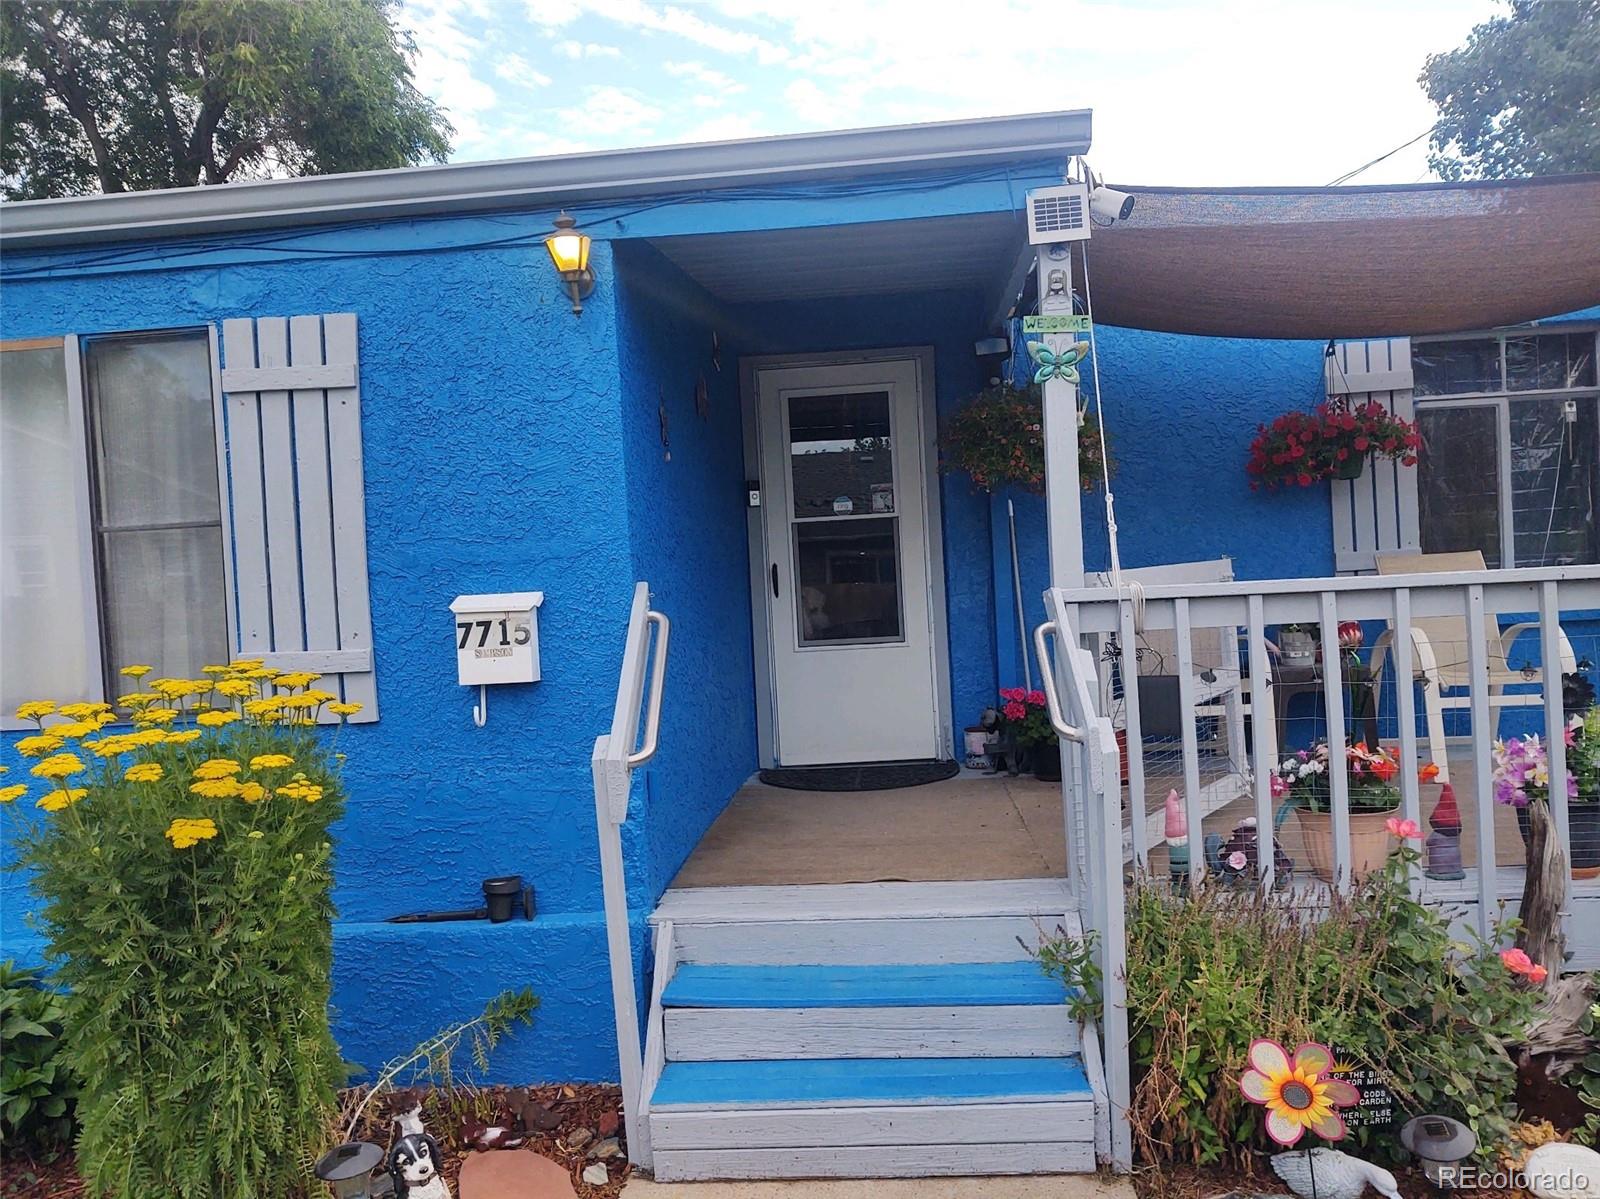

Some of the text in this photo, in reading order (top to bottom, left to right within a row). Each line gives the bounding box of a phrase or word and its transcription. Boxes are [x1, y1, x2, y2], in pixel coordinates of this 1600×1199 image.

[1025, 318, 1089, 329] WELCOME
[457, 619, 531, 649] 7715
[1333, 1072, 1345, 1080] OF
[1348, 1071, 1366, 1079] THE
[1346, 1119, 1359, 1127] ON
